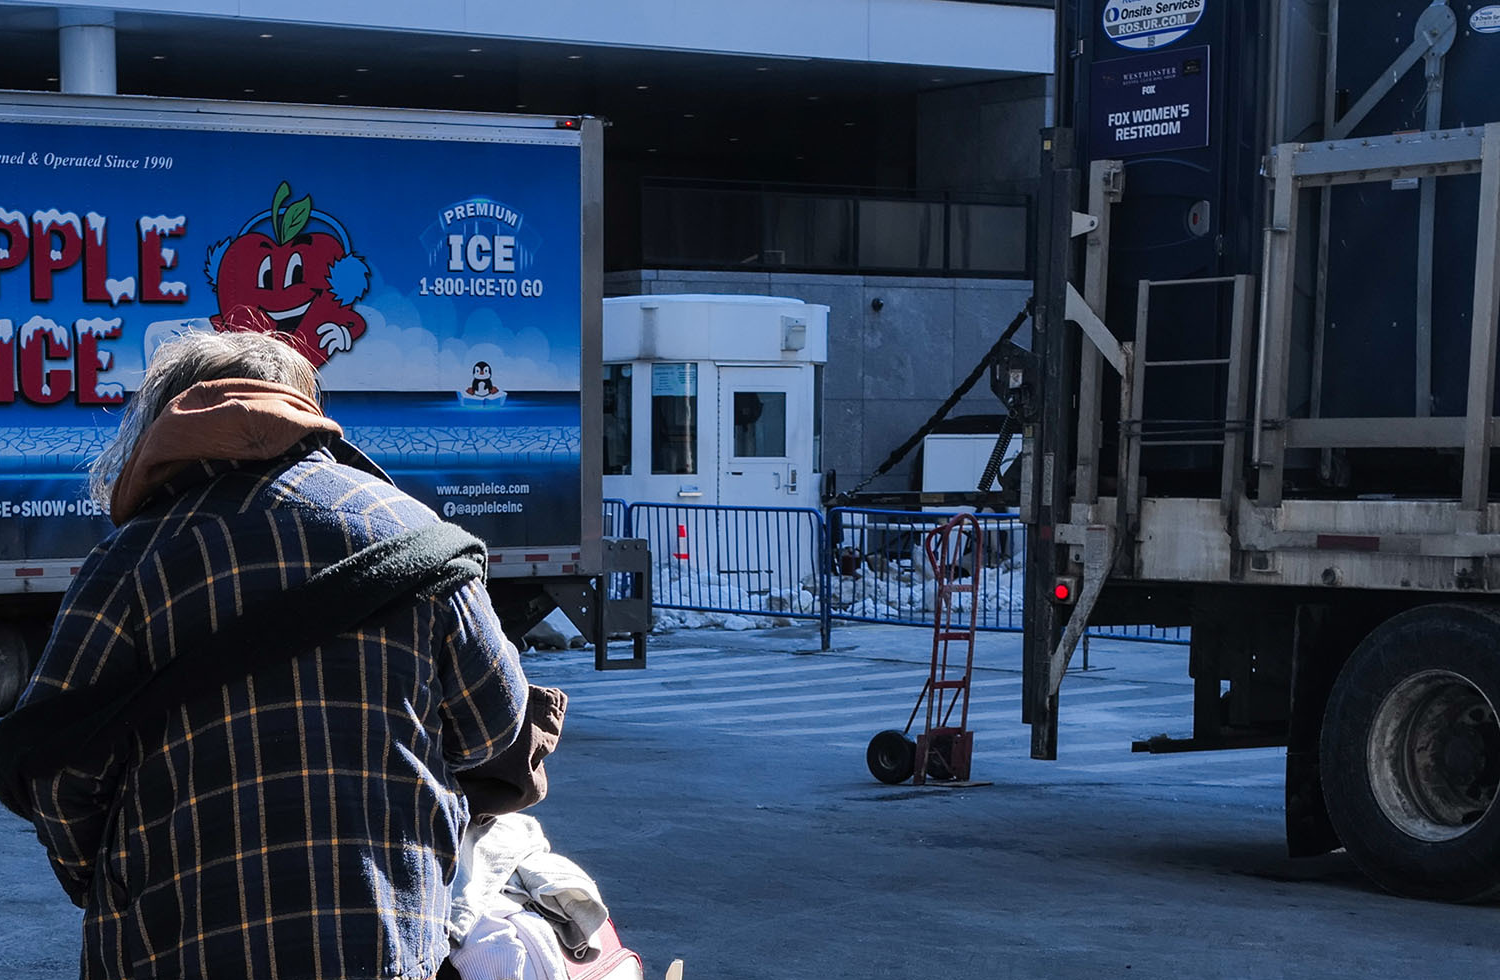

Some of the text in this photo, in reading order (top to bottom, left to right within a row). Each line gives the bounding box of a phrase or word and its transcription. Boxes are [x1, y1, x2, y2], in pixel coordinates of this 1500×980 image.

[1121, 0, 1201, 20] Onsite Services
[1118, 14, 1187, 34] ROS.UR.COM
[1142, 85, 1156, 95] FOX
[1108, 104, 1190, 127] FOX WOMEN'S
[1115, 121, 1181, 141] RESTROOM
[28, 152, 39, 165] &
[43, 152, 101, 169] Operated
[104, 154, 139, 169] Since
[143, 156, 173, 170] 1990
[444, 203, 518, 226] PREMIUM
[448, 234, 516, 273] ICE
[419, 277, 543, 298] 1-800-ICE-TO GO
[21, 500, 66, 517] SNOW
[77, 499, 102, 516] ICE
